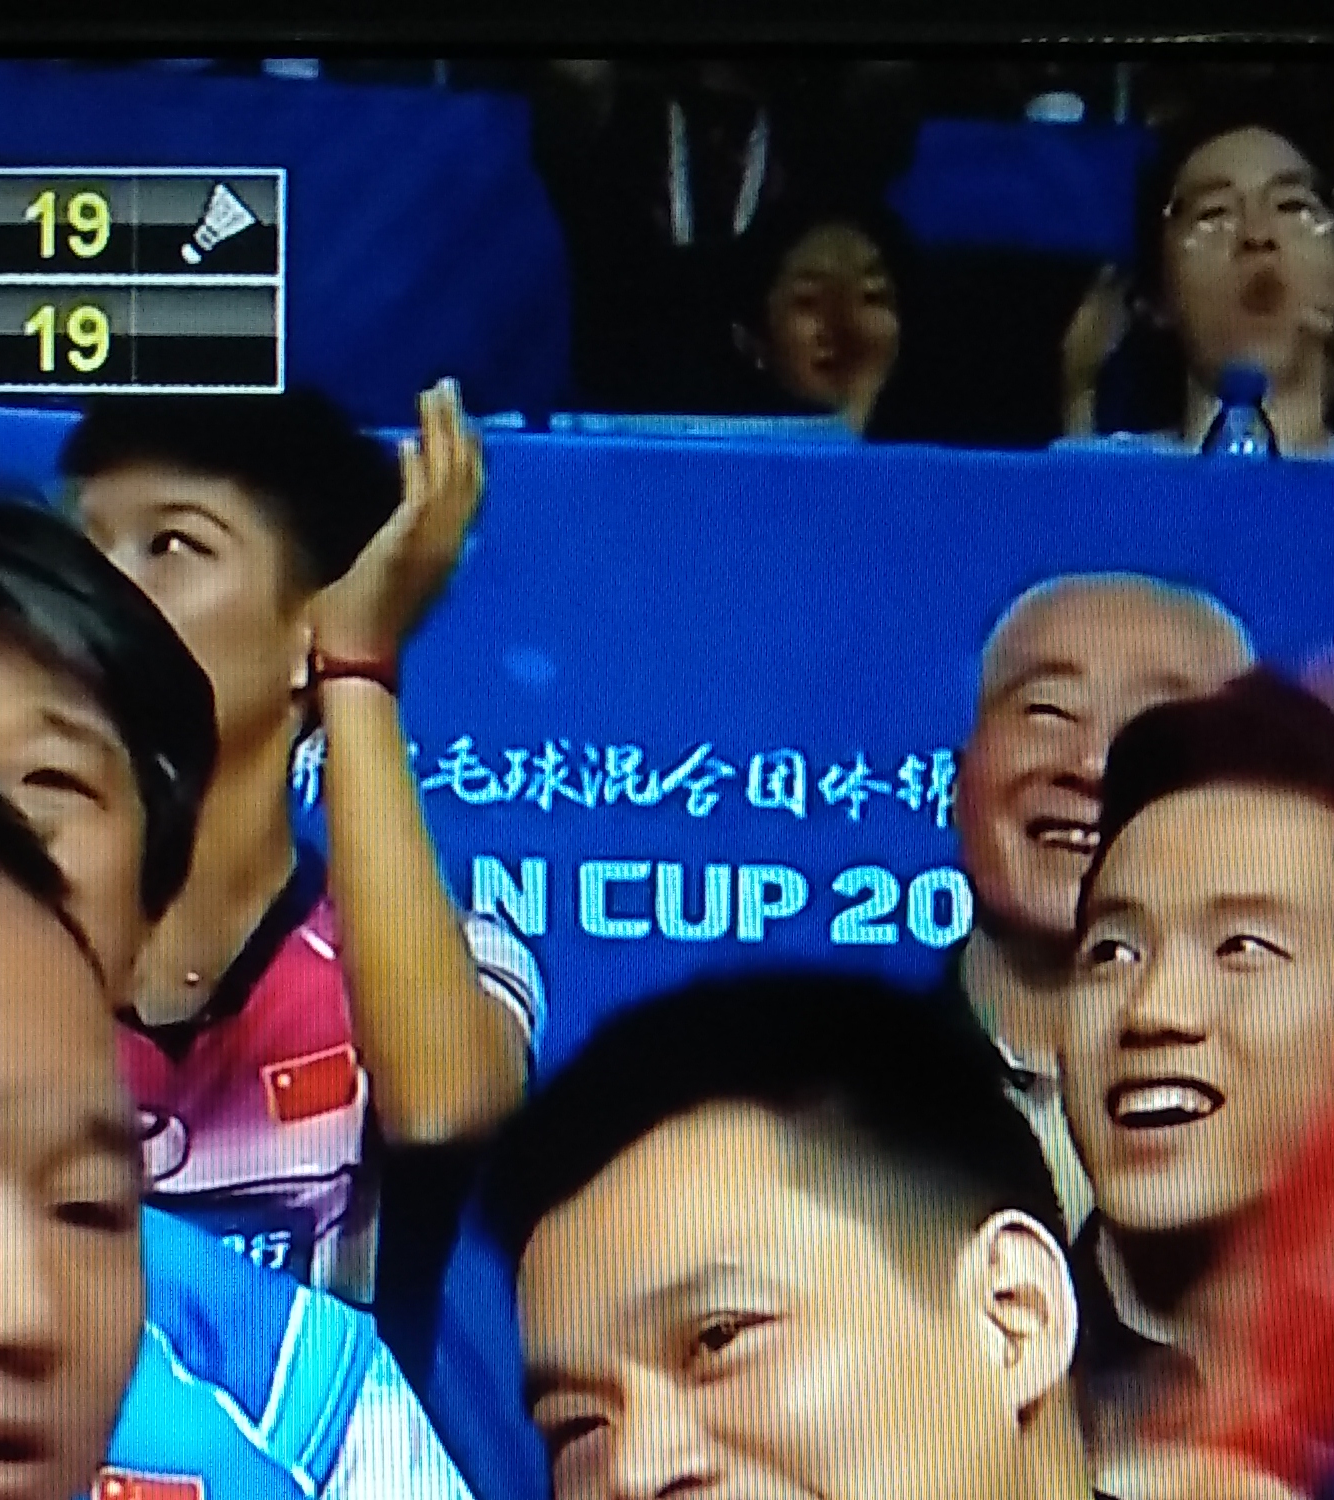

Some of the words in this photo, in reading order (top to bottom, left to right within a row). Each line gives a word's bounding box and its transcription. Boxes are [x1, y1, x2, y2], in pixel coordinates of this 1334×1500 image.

[25, 190, 111, 260] 19
[25, 305, 111, 373] 19
[409, 734, 960, 828] 毛球混合团体锦
[579, 859, 809, 942] CUP
